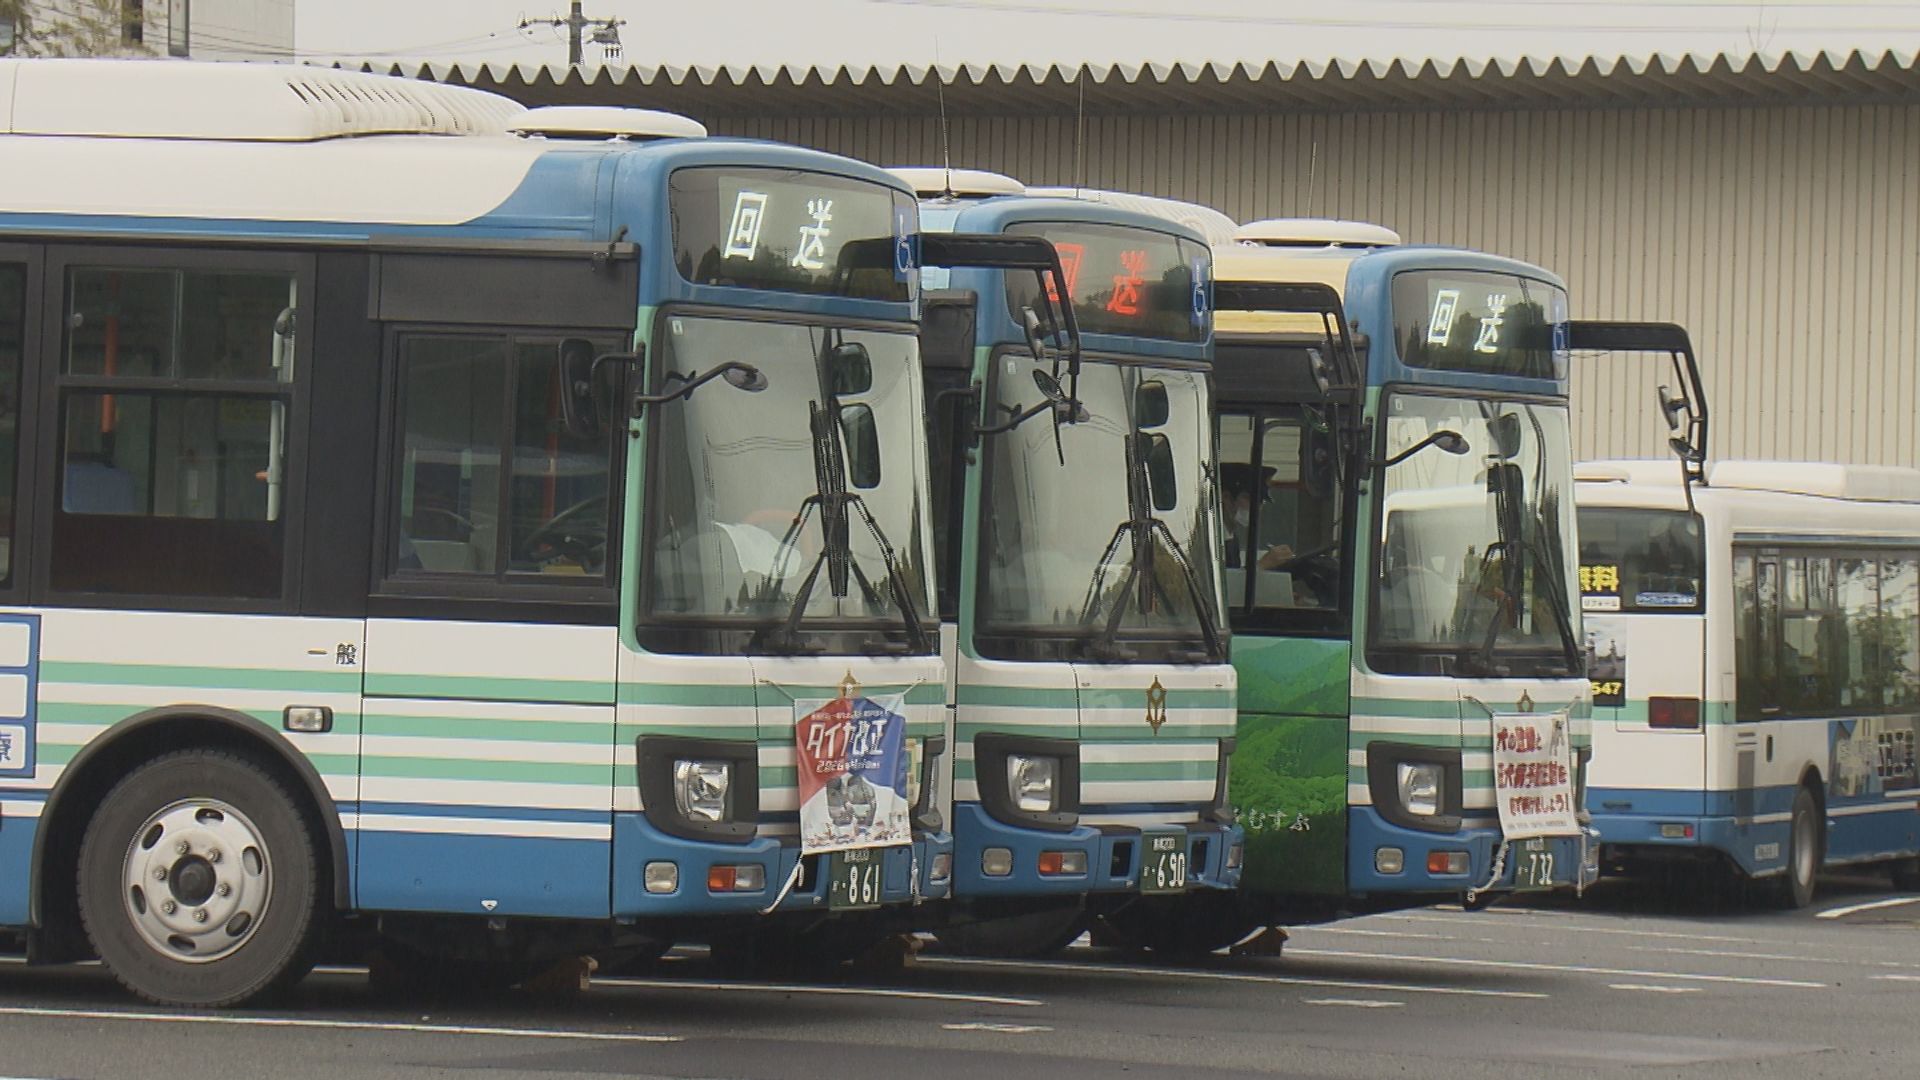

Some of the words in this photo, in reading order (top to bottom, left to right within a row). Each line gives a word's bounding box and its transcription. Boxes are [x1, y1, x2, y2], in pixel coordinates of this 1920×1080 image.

[723, 191, 833, 269] 回送
[1427, 288, 1507, 353] 回送
[307, 643, 357, 666] 一般
[849, 864, 880, 904] 861
[1157, 852, 1185, 888] 690
